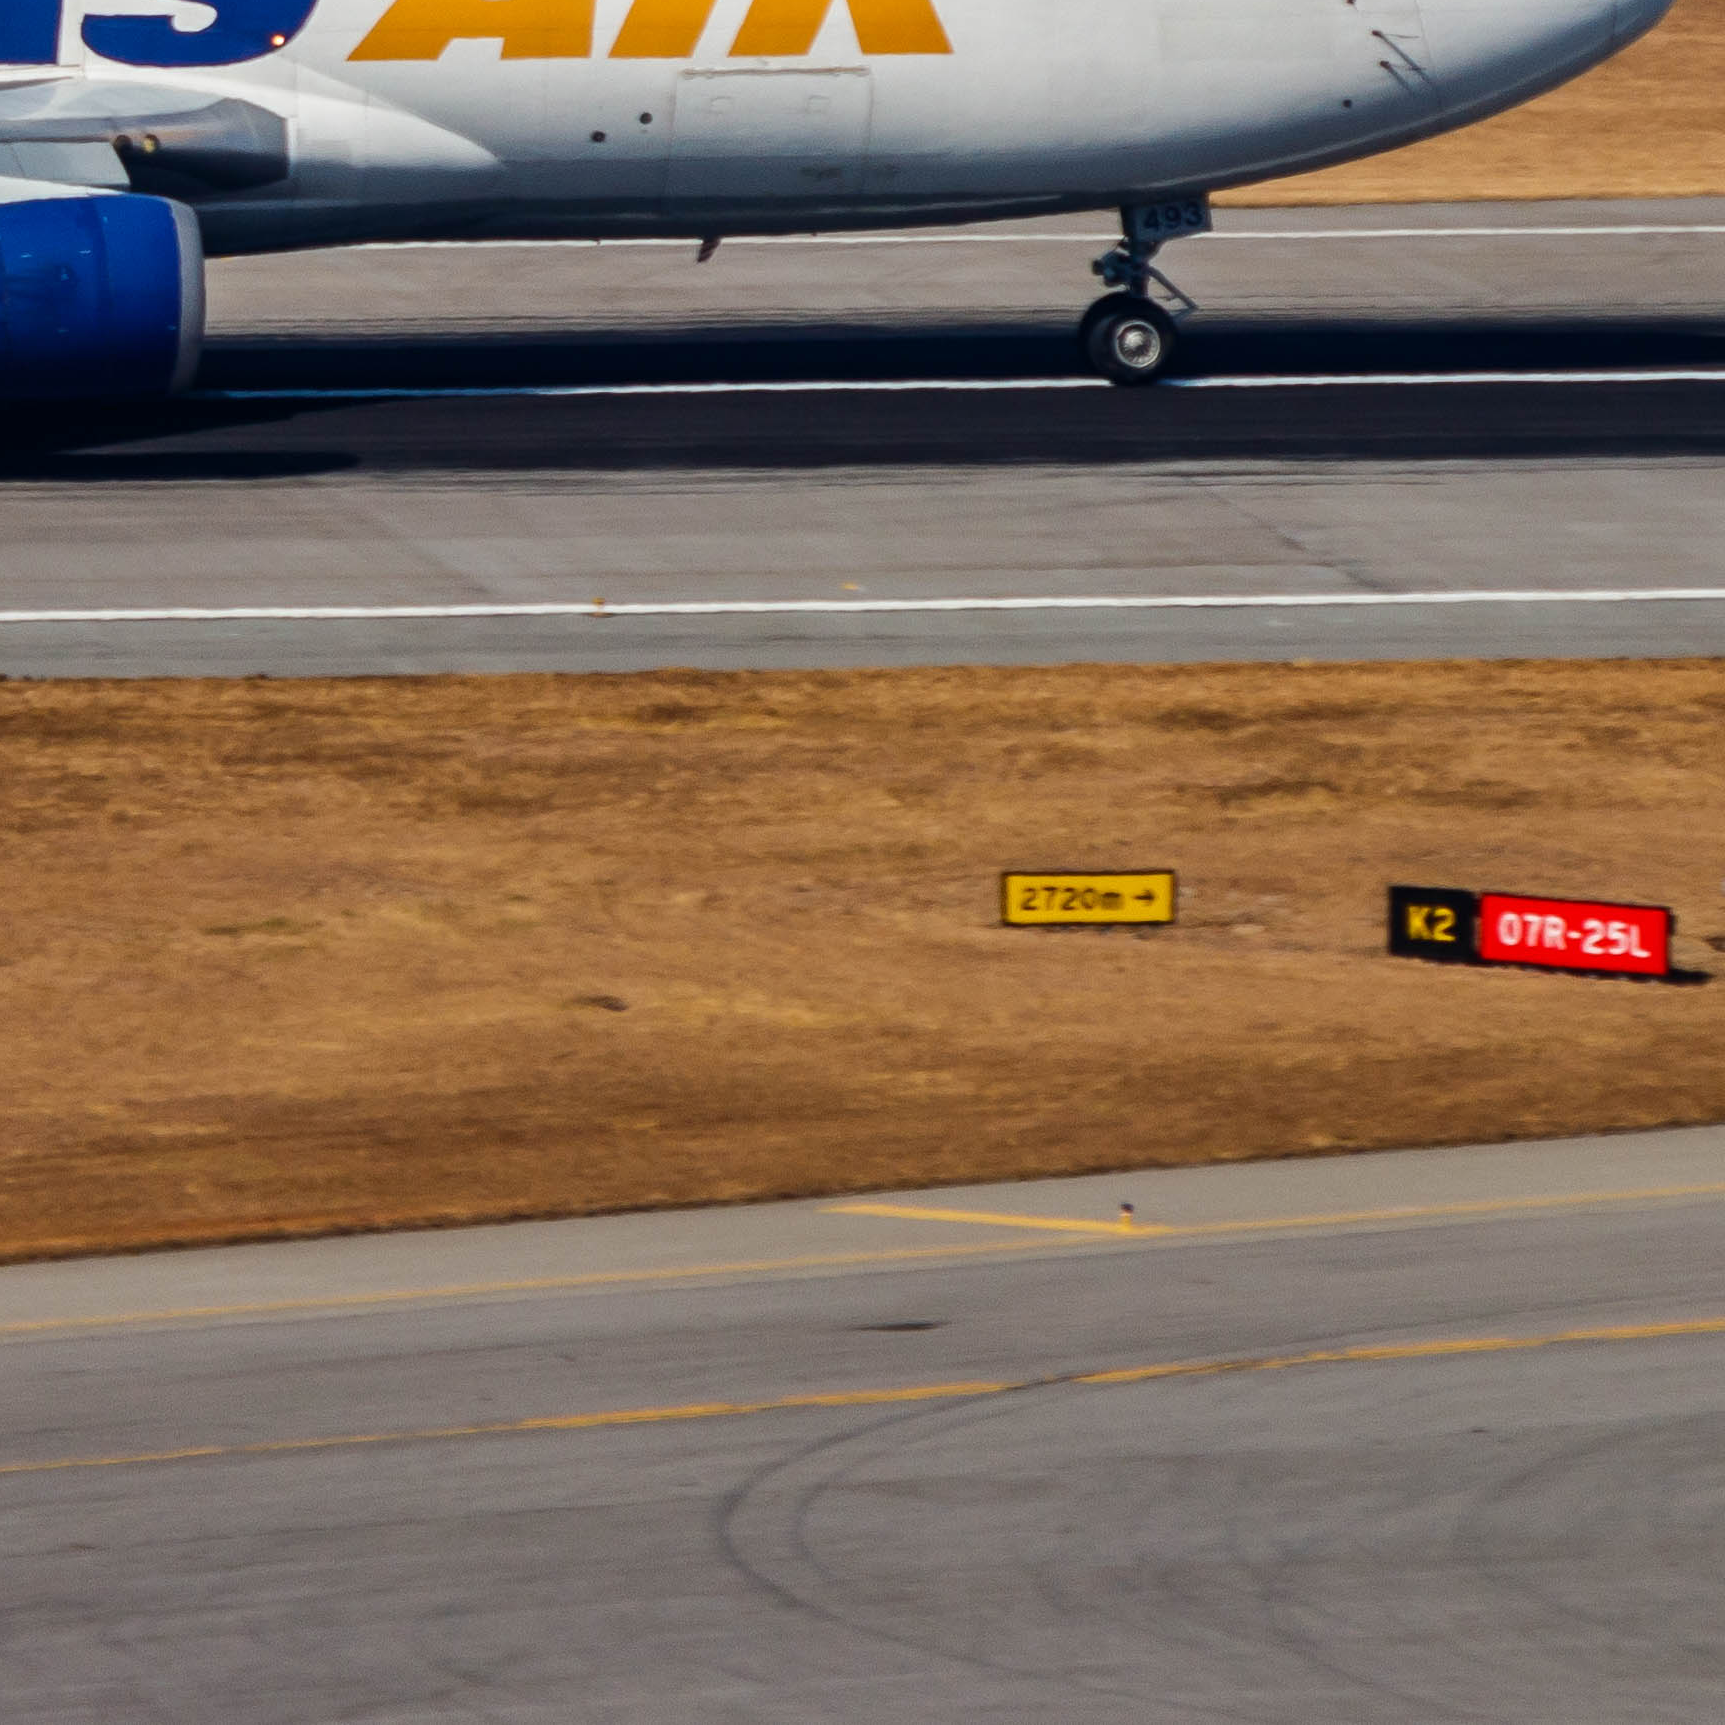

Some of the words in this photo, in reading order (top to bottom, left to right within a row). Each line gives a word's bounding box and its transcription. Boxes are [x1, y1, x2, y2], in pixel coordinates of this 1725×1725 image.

[1143, 201, 1204, 230] 493
[1021, 886, 1124, 911] 2720m
[1406, 905, 1456, 942] K2
[1498, 911, 1651, 958] 07R-25L
